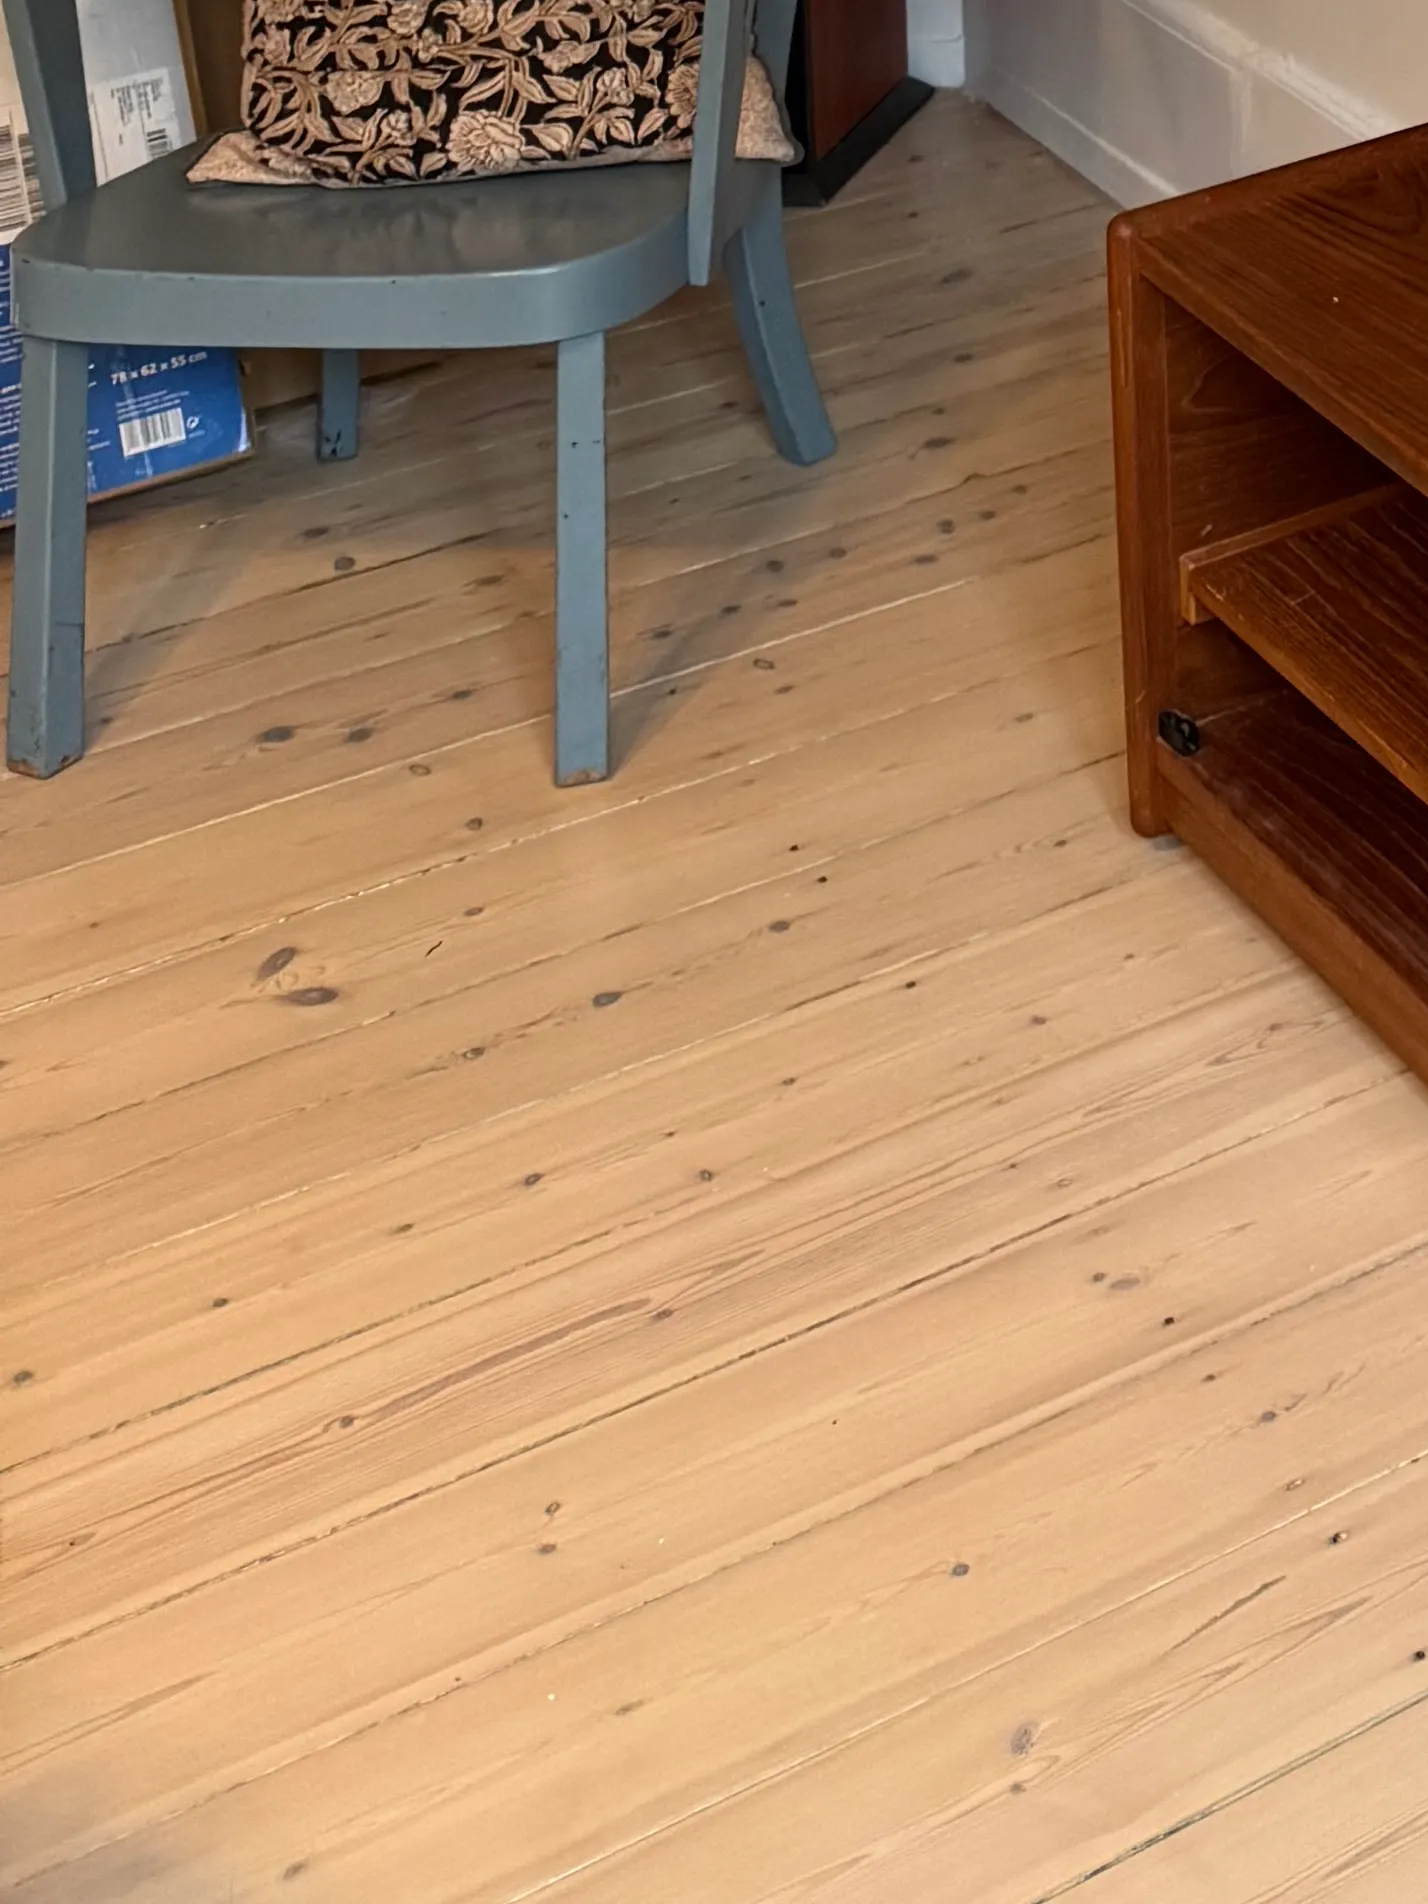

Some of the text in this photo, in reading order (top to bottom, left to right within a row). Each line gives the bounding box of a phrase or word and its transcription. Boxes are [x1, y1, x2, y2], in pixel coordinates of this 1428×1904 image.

[110, 351, 208, 386] 78 62 55 cm
